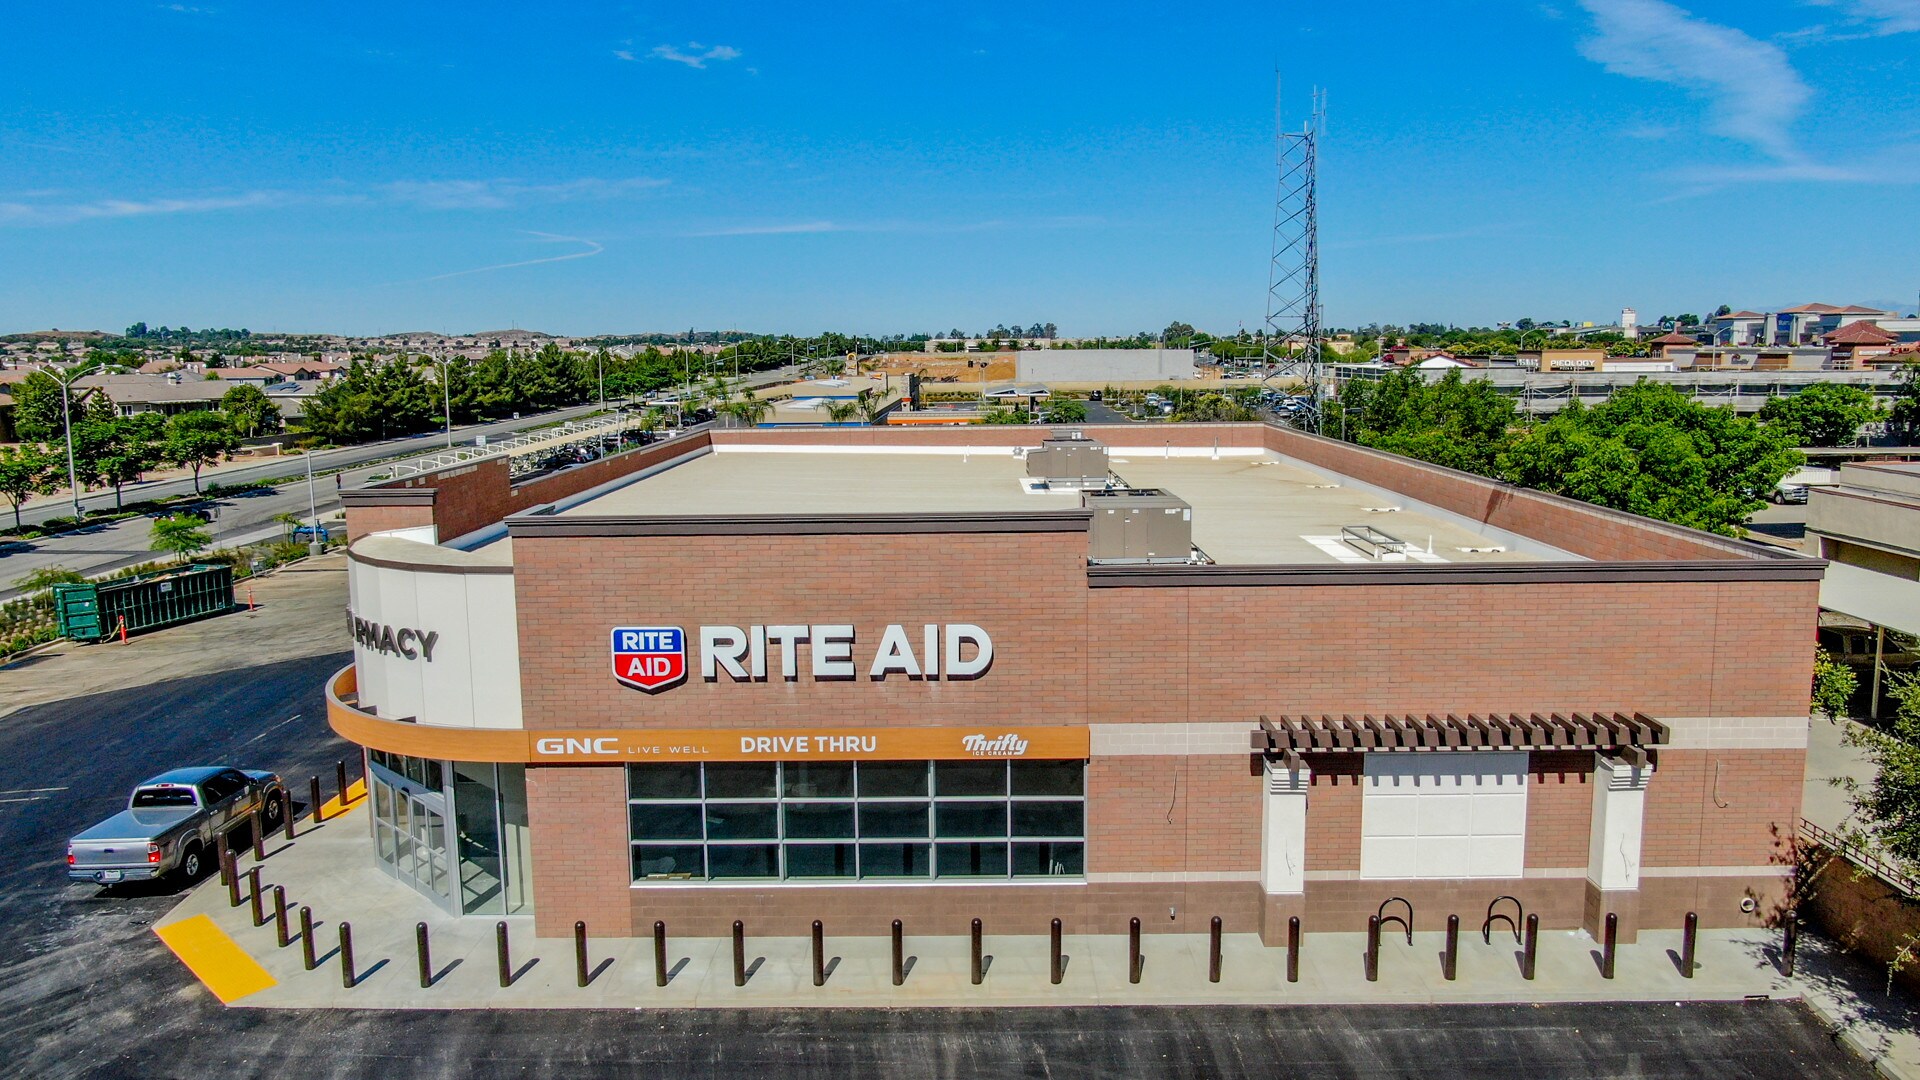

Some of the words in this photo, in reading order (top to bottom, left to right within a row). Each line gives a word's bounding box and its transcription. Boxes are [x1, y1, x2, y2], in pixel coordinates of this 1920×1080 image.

[622, 631, 674, 650] RITE
[700, 624, 856, 681] RITE
[869, 624, 994, 681] AID
[627, 657, 671, 677] AID
[536, 737, 619, 755] GNC
[628, 746, 660, 754] LIVE
[669, 746, 710, 754] WELL
[740, 736, 809, 753] DRIVE
[814, 736, 877, 753] THRU
[962, 733, 1029, 755] Thrifty
